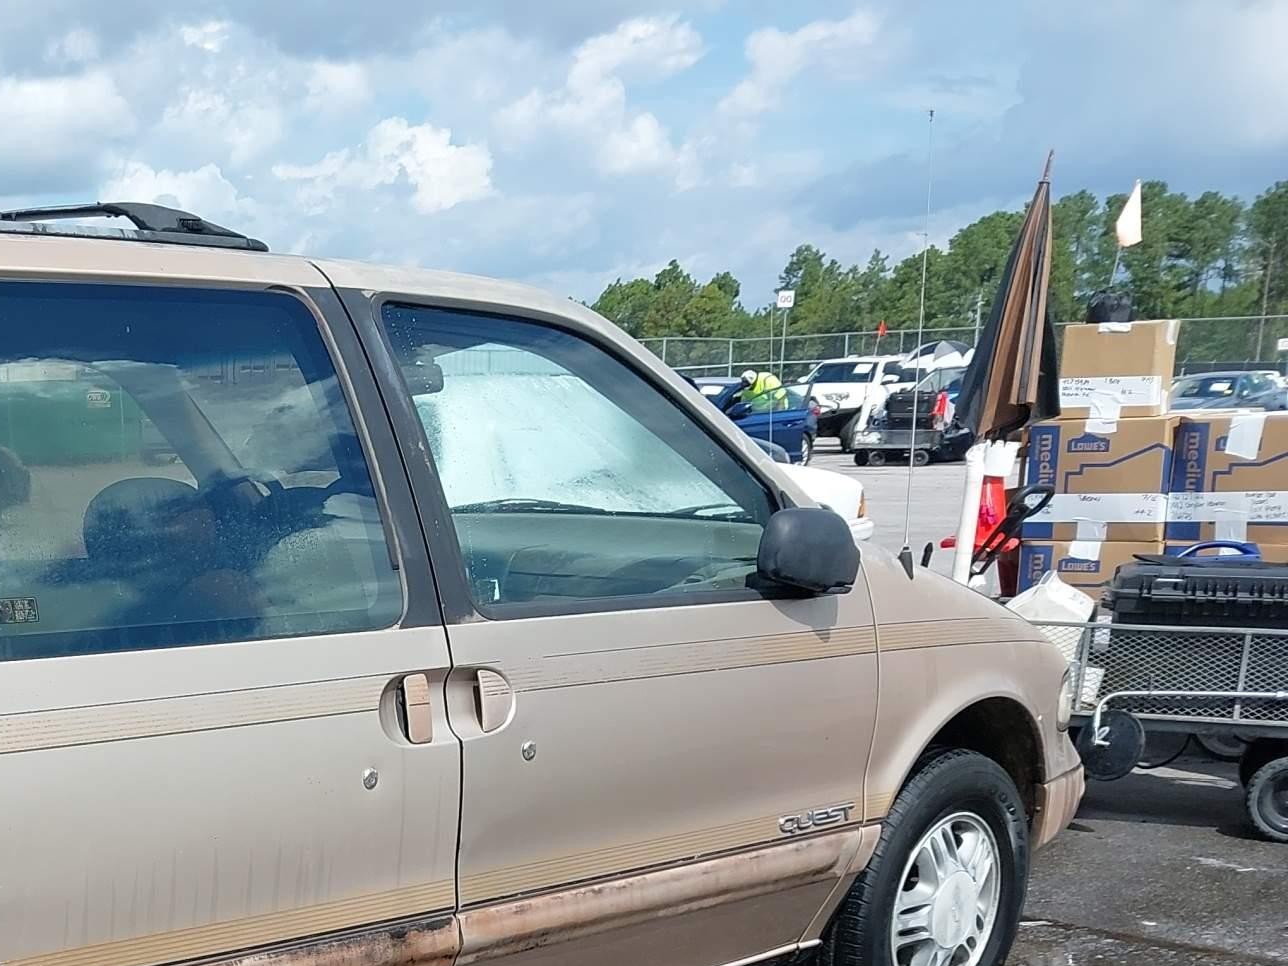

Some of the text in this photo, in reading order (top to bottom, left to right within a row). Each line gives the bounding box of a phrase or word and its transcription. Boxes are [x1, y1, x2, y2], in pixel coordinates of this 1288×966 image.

[1038, 434, 1053, 485] mediu
[1185, 431, 1201, 491] mediu
[778, 800, 856, 834] QUEST
